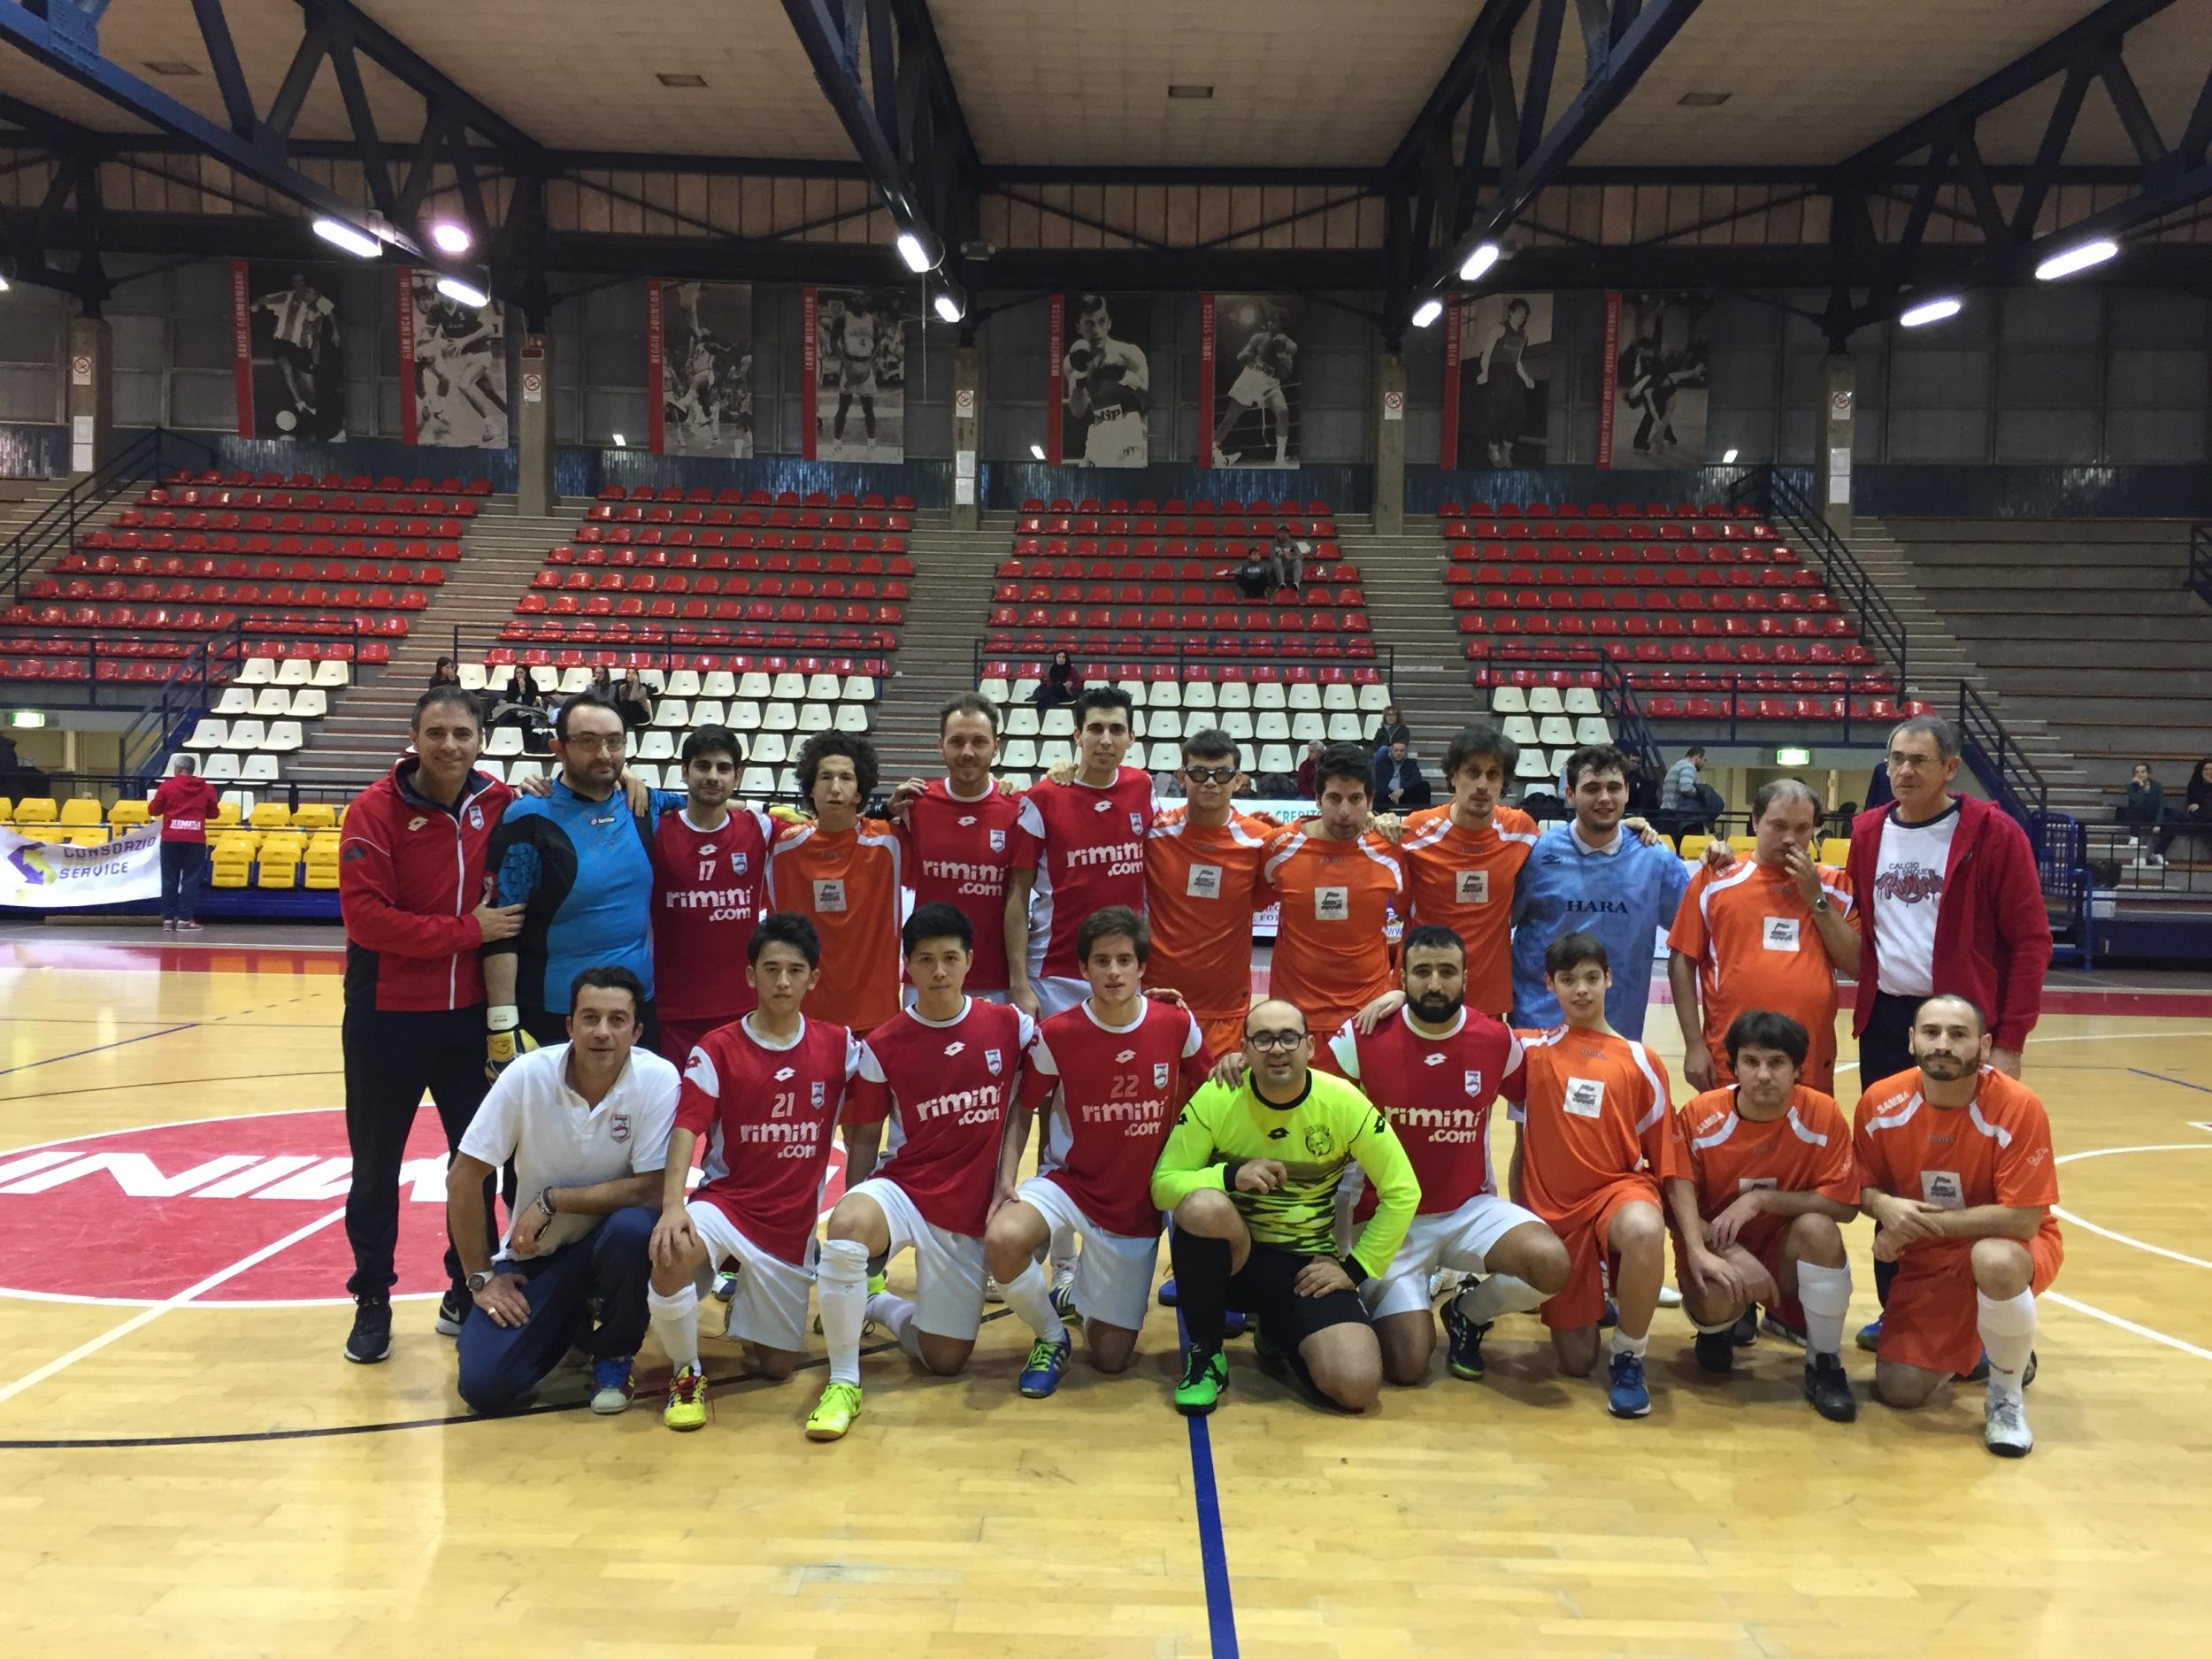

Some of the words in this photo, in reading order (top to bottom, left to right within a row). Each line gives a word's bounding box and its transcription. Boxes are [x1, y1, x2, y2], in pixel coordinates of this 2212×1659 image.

[650, 289, 660, 332] JOHNSON
[805, 346, 814, 371] LARRY
[1050, 336, 1061, 377] MAURIZIO
[63, 837, 157, 859] CONSORZIO
[1066, 841, 1144, 868] rimini
[58, 862, 129, 879] SERVICE
[698, 860, 716, 881] 17
[923, 859, 1009, 882] rimini
[1107, 861, 1144, 878] .com
[666, 886, 753, 908] rimini
[958, 883, 1002, 896] .com
[709, 907, 751, 922] .com
[1567, 900, 1628, 914] HARA
[1110, 1074, 1140, 1099] 22
[771, 1092, 795, 1118] 21
[917, 1081, 1004, 1122] rimini
[1081, 1095, 1168, 1123] rimini
[1877, 1091, 1910, 1115] SAMBA
[958, 1107, 1000, 1126] .com
[1384, 1105, 1485, 1128] rimini
[1428, 1129, 1477, 1144] .com
